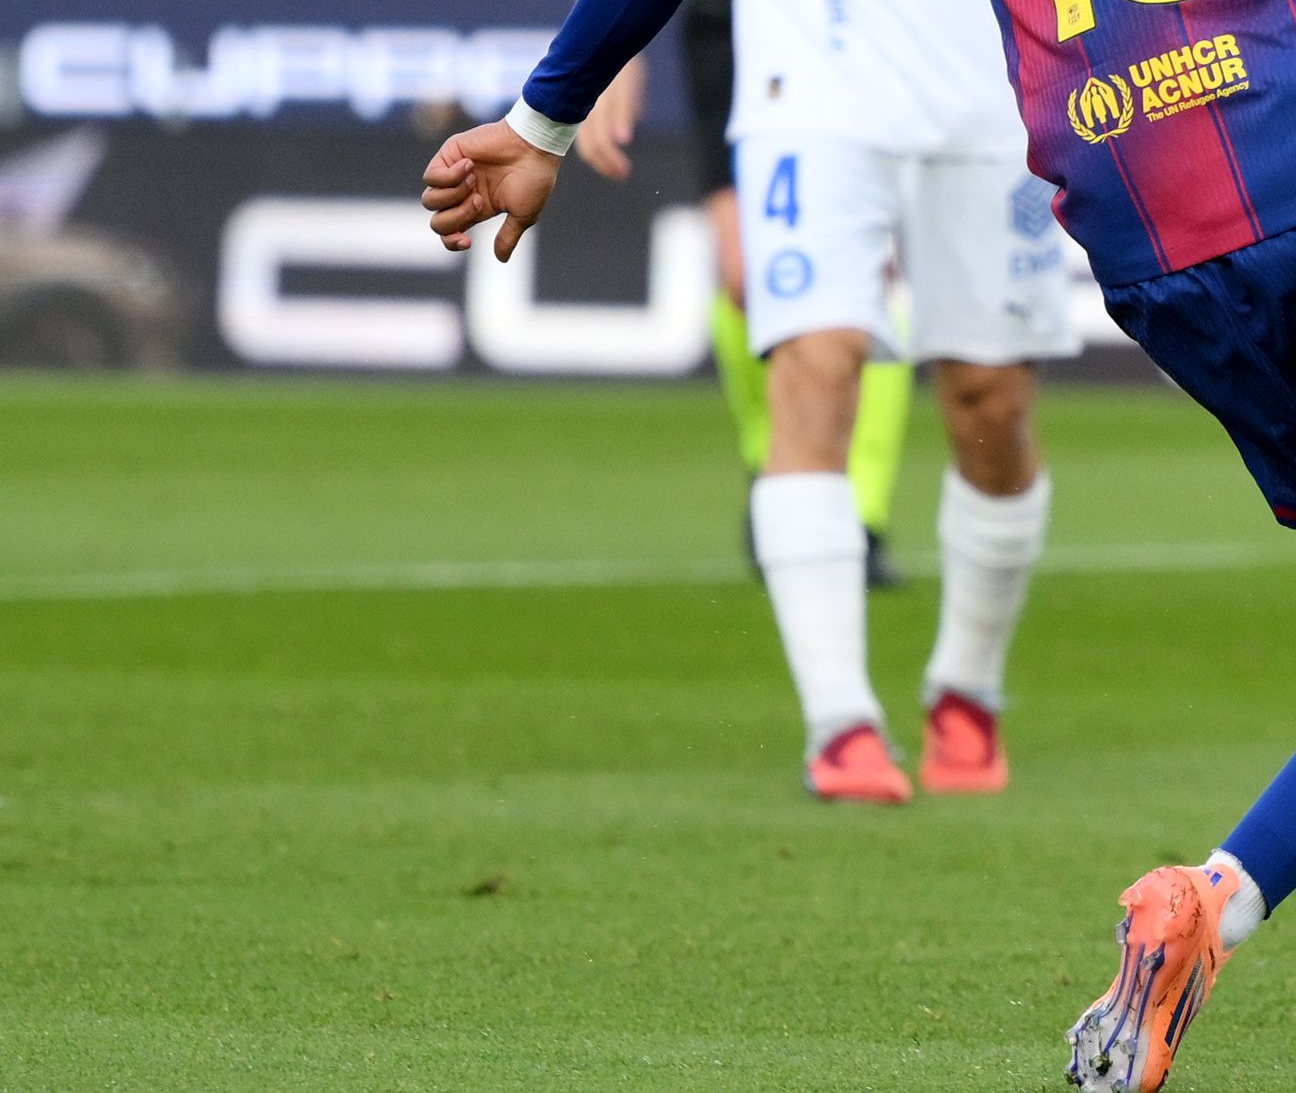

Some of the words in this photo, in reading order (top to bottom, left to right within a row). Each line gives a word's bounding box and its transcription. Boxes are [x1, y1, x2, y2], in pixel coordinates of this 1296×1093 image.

[1128, 33, 1240, 88] UNHCR
[1142, 57, 1248, 114] ACNUR
[1146, 111, 1165, 123] The
[1163, 104, 1180, 117] UN
[1178, 93, 1216, 112] Refugee
[1216, 80, 1250, 99] Agency
[764, 153, 799, 228] 4
